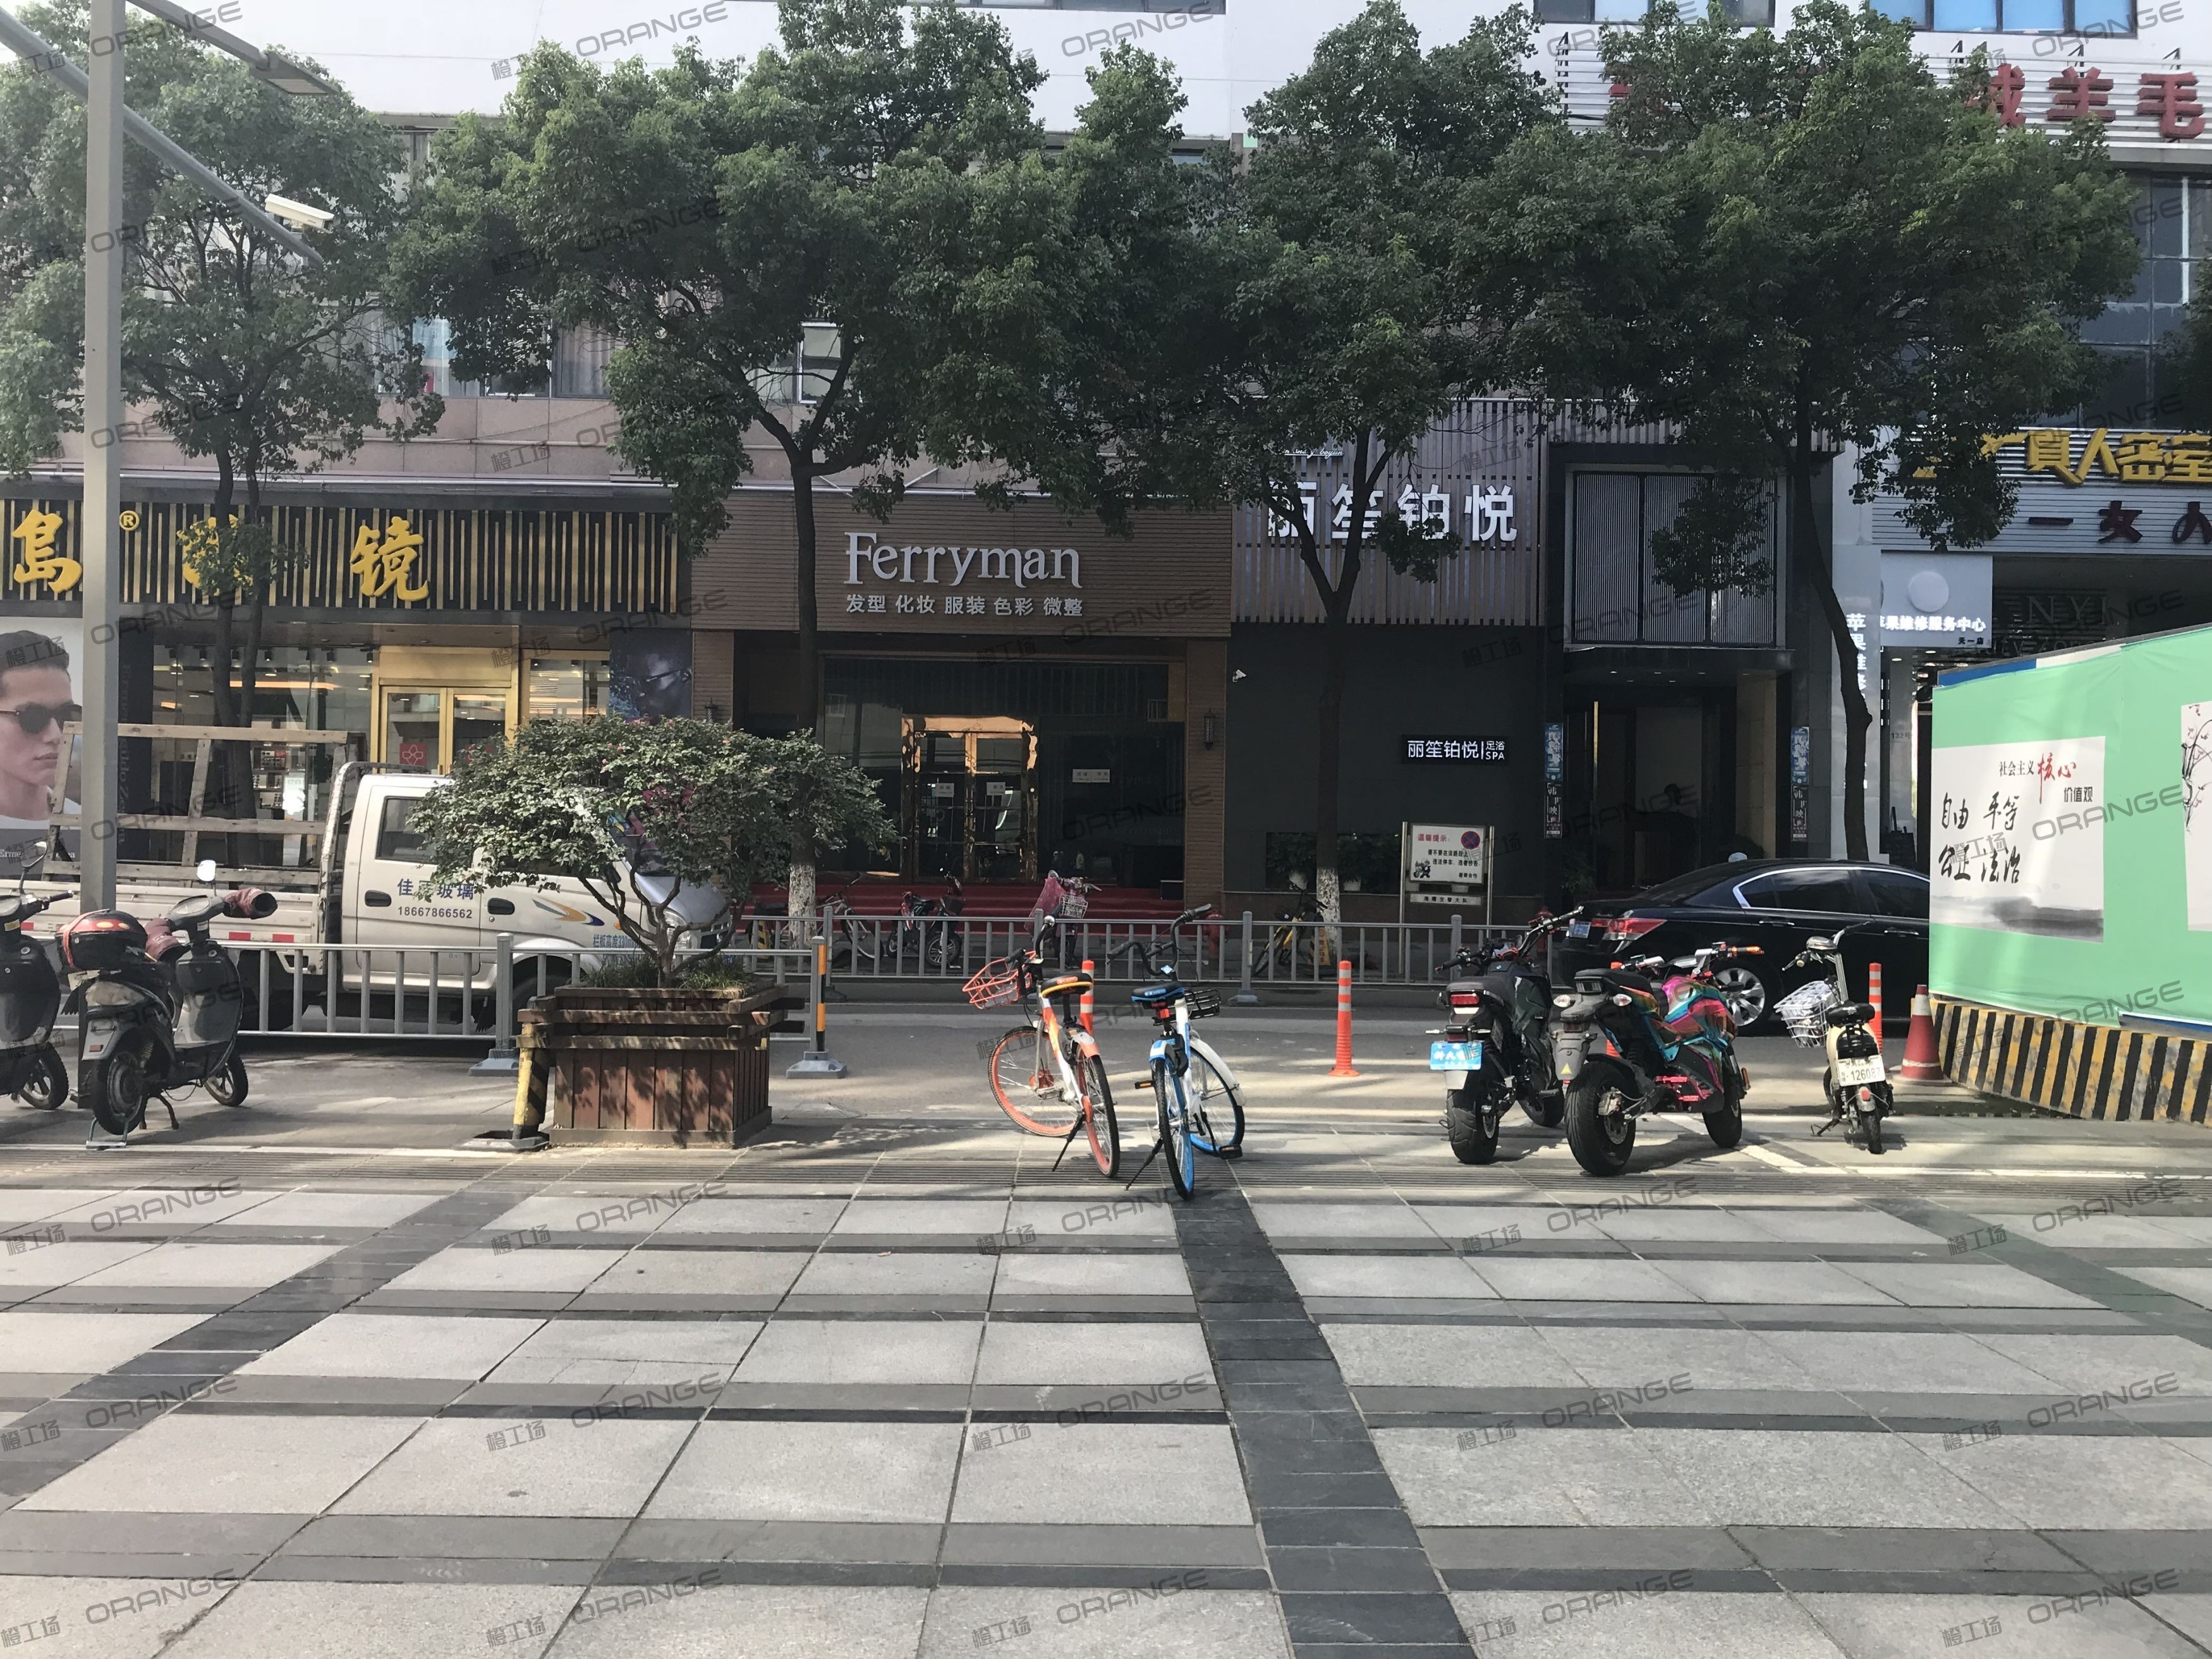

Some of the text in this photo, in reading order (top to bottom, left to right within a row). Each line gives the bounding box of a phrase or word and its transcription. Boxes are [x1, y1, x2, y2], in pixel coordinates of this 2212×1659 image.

[844, 532, 1083, 588] Ferryman
[846, 594, 1083, 617] 发型 化妆 服装 色彩 微整
[1958, 636, 1984, 645] 天一店
[1407, 740, 1505, 759] 丽笙铂悦 足浴
[1485, 751, 1505, 760] SPA
[1999, 760, 2034, 777] 社会主义
[2063, 786, 2093, 803] 价值观
[1942, 791, 2020, 831] 自由 平等
[1938, 843, 2021, 884] 公正 法治
[398, 906, 473, 919] 18667866562
